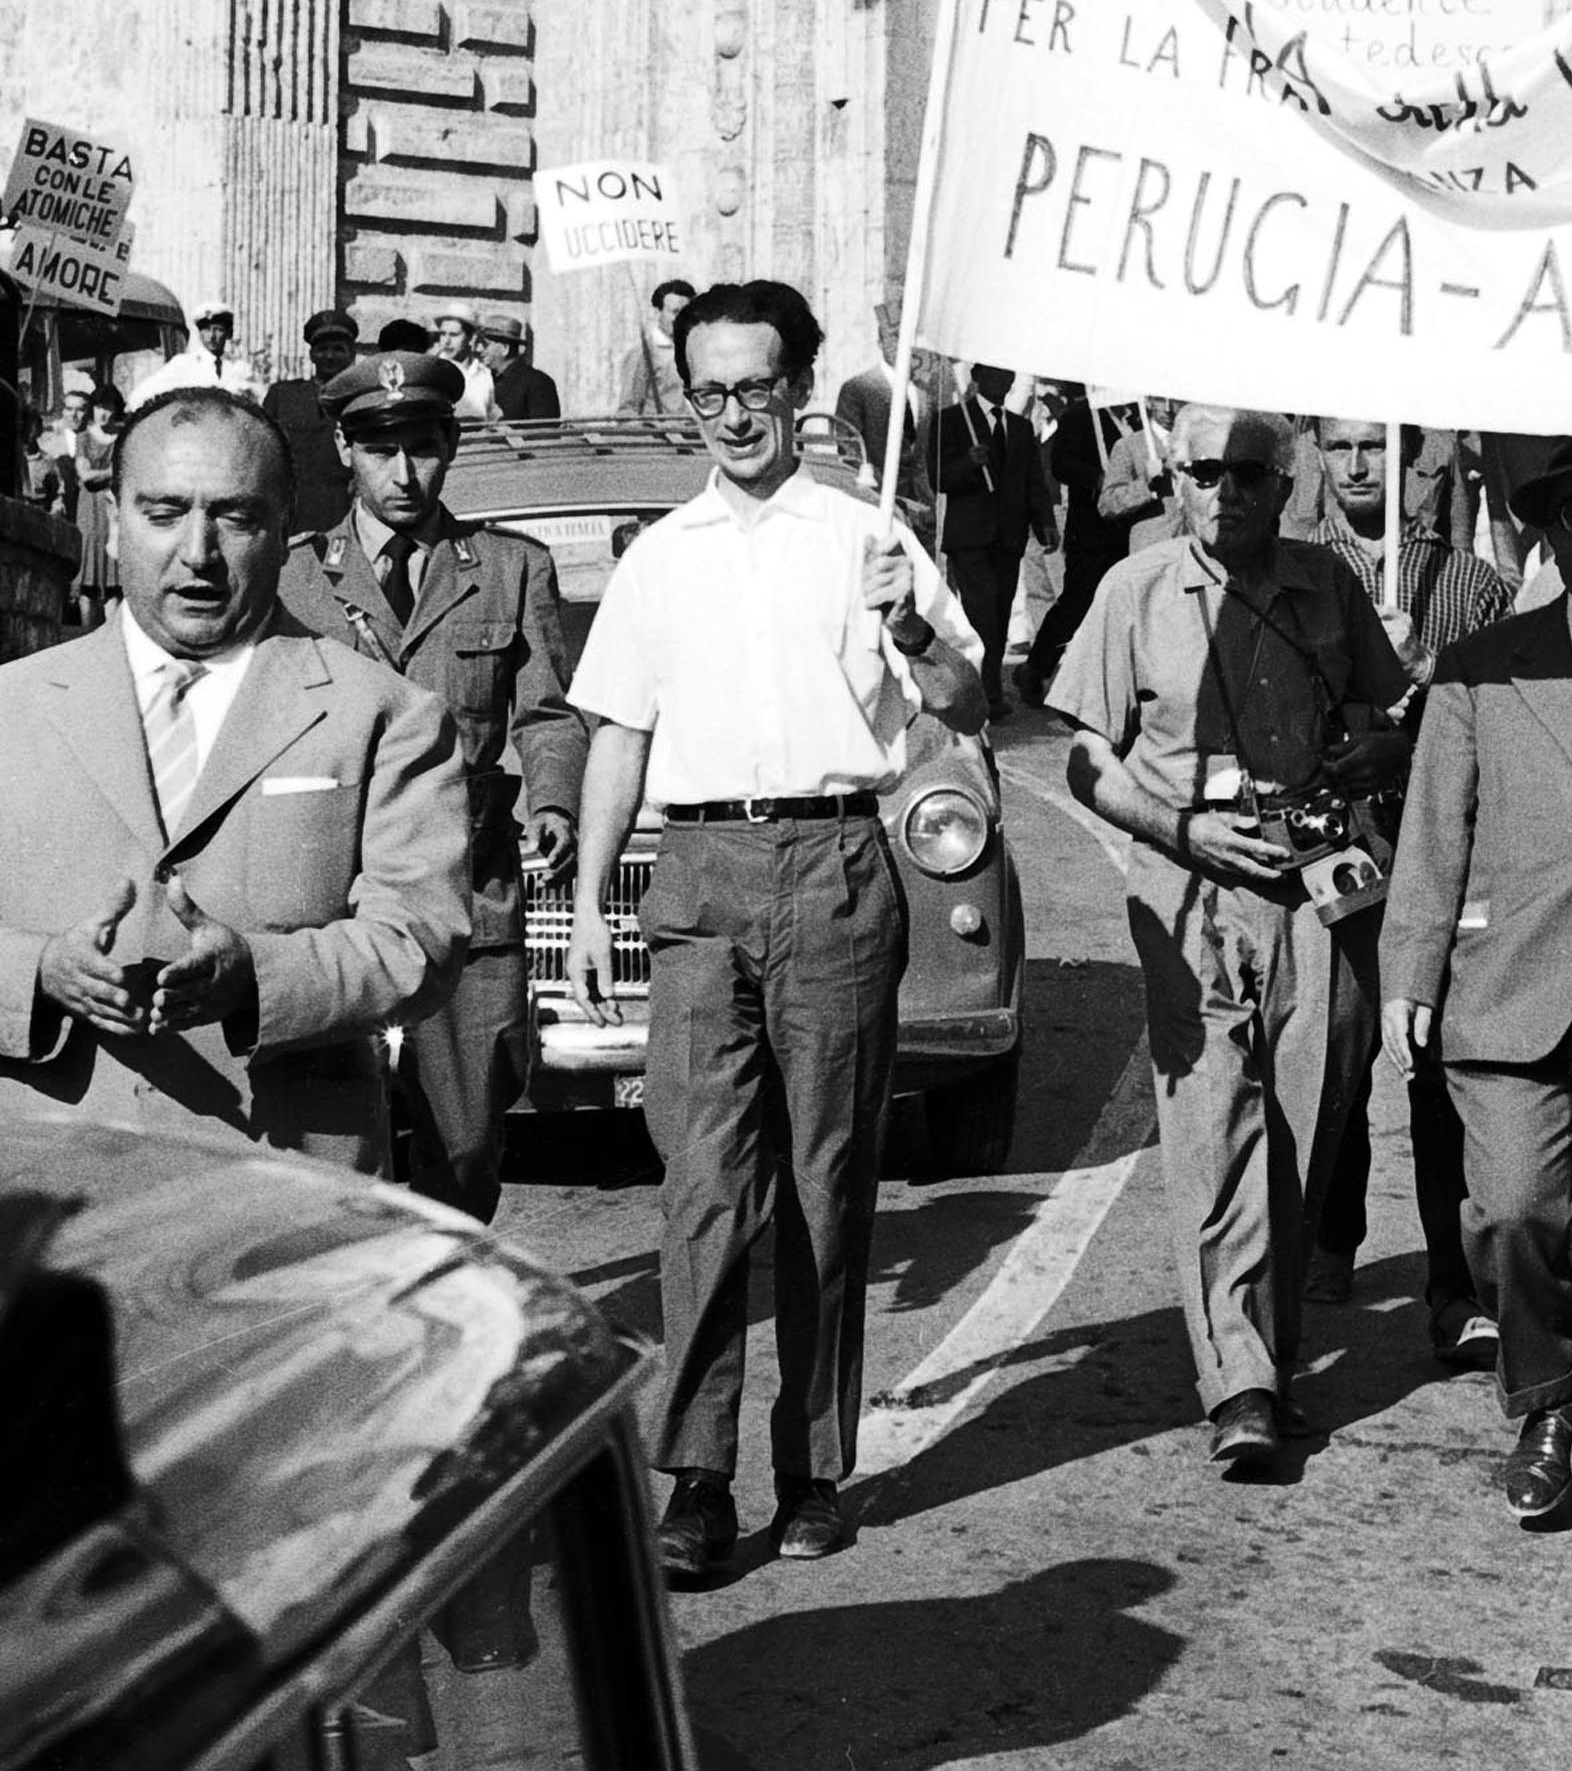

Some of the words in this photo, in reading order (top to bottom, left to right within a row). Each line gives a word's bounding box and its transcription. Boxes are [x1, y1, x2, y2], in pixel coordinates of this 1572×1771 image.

[1118, 14, 1181, 81] LA
[24, 127, 134, 183] BASTA
[11, 189, 119, 238] ATOMICHE
[555, 171, 664, 208] NON
[564, 218, 681, 259] UCCIDERE
[15, 242, 120, 307] AMORE
